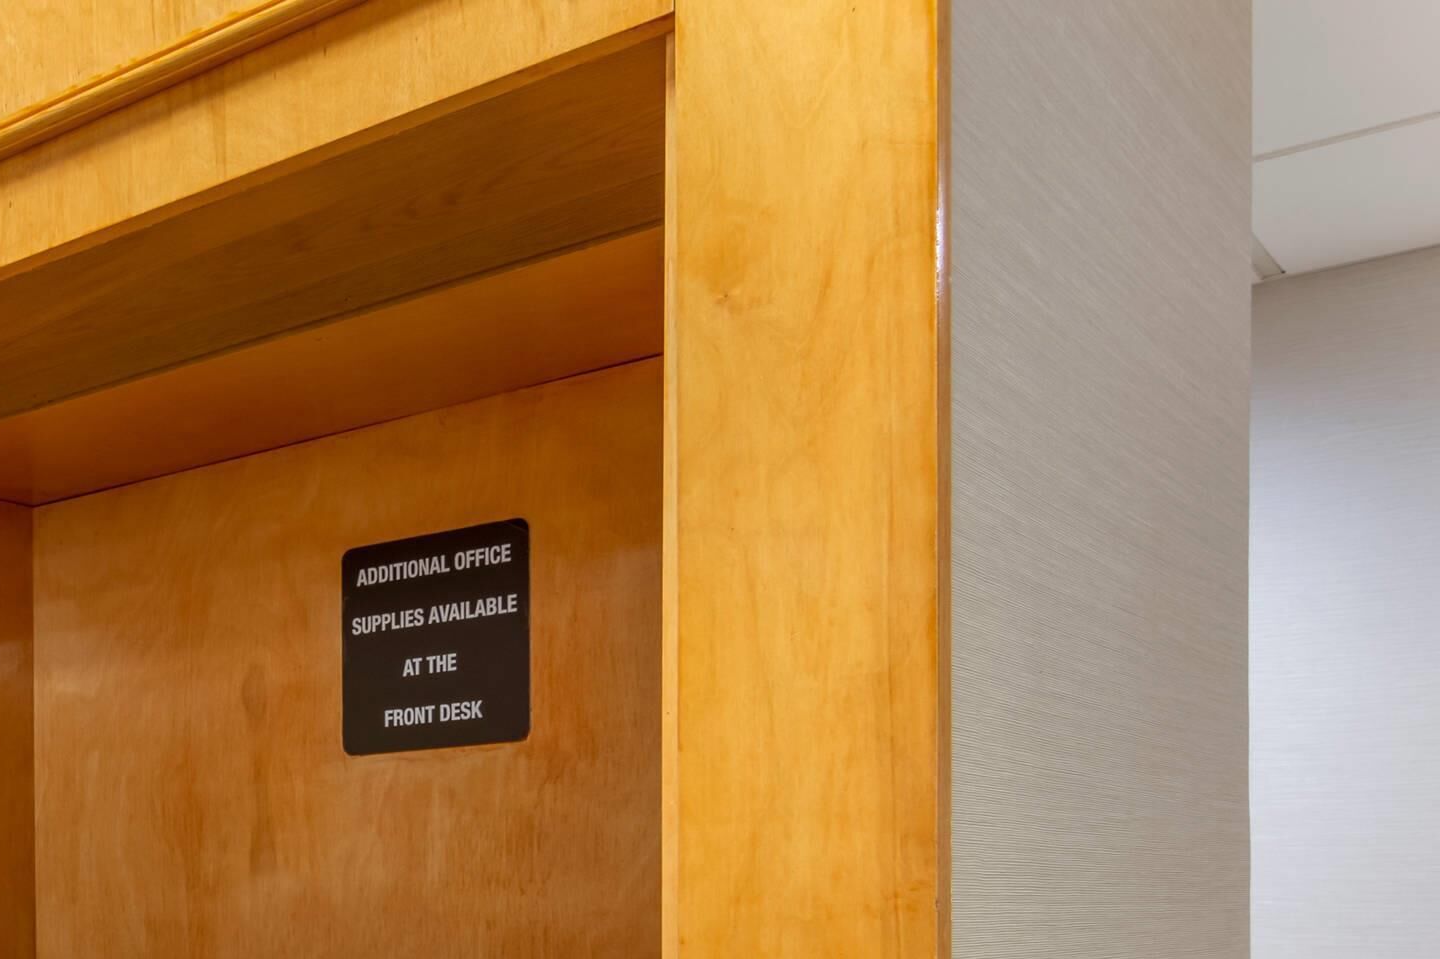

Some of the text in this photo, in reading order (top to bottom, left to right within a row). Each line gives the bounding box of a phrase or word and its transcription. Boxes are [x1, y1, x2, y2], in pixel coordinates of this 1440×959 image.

[356, 543, 512, 587] ADDITIONAL OFFICE
[351, 593, 518, 635] SUPPLIES AVAILABLE
[402, 653, 457, 677] AT THE
[384, 700, 483, 728] FRONT DESK
